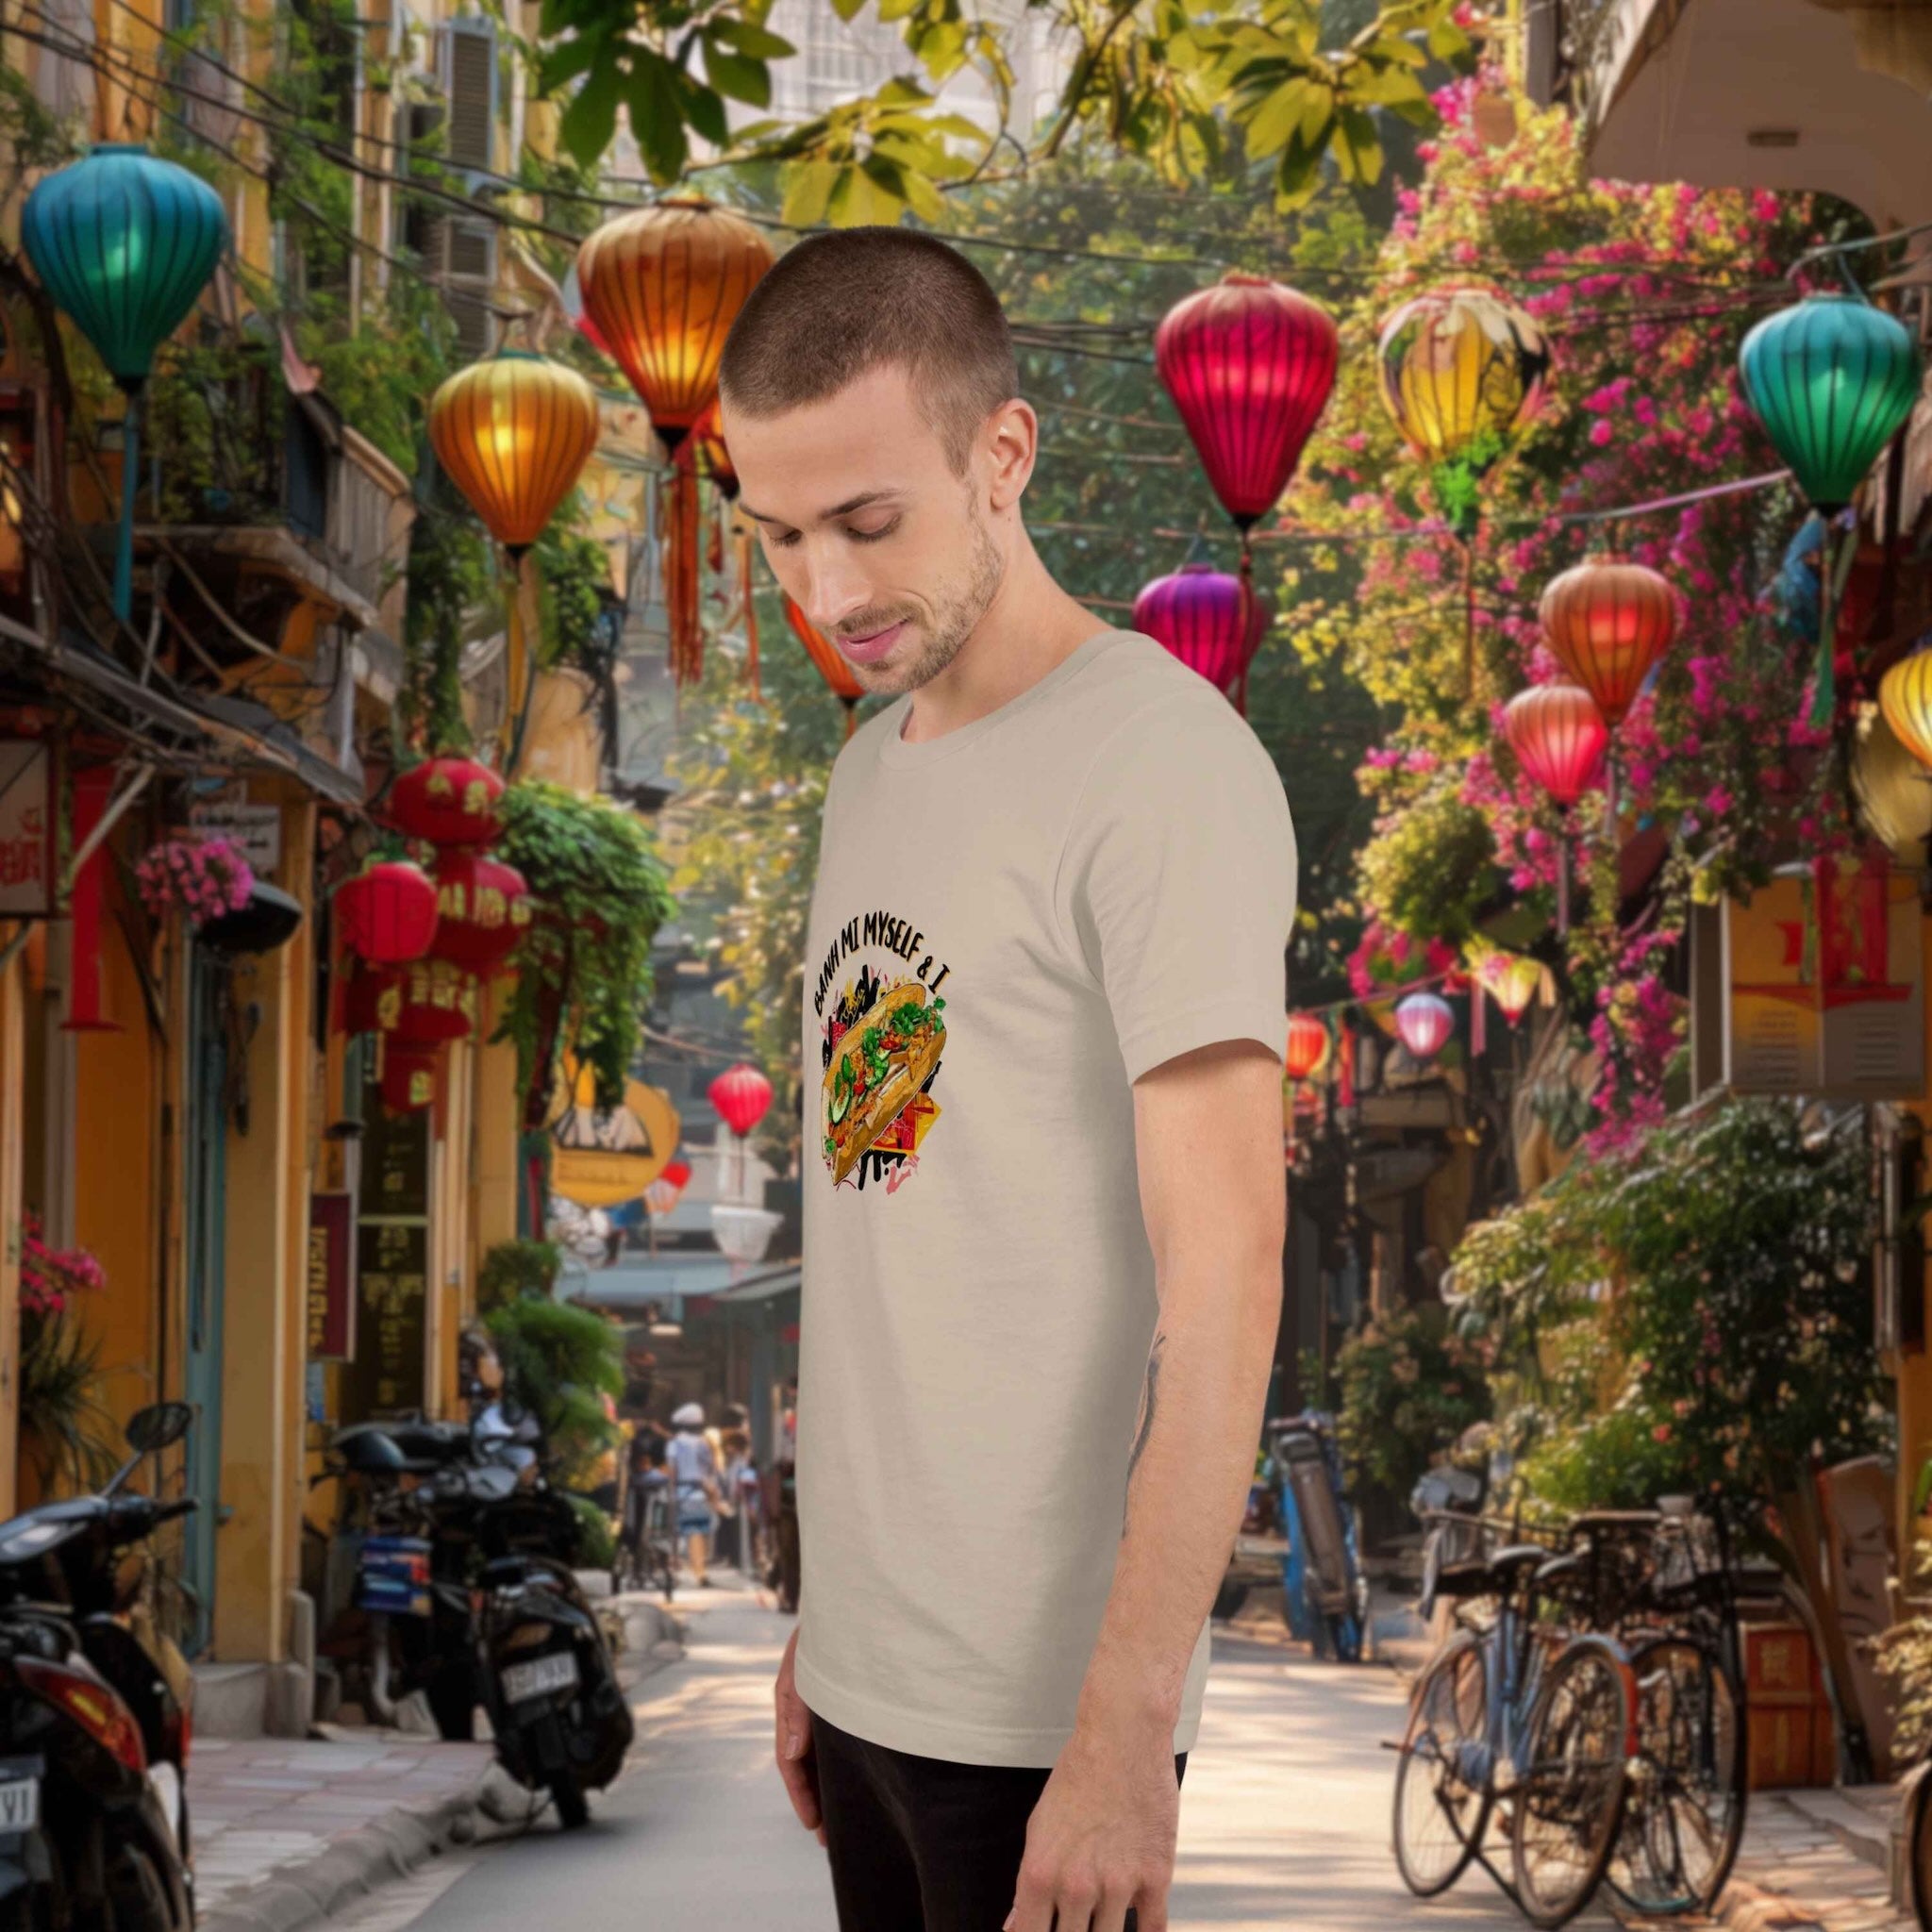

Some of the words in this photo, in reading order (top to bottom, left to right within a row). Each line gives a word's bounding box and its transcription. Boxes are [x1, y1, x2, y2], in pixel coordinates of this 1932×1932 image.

[814, 939, 840, 1018] BANH
[841, 916, 859, 959] MI
[863, 910, 924, 962] MYSELF
[917, 956, 933, 981] &
[927, 963, 950, 994] I
